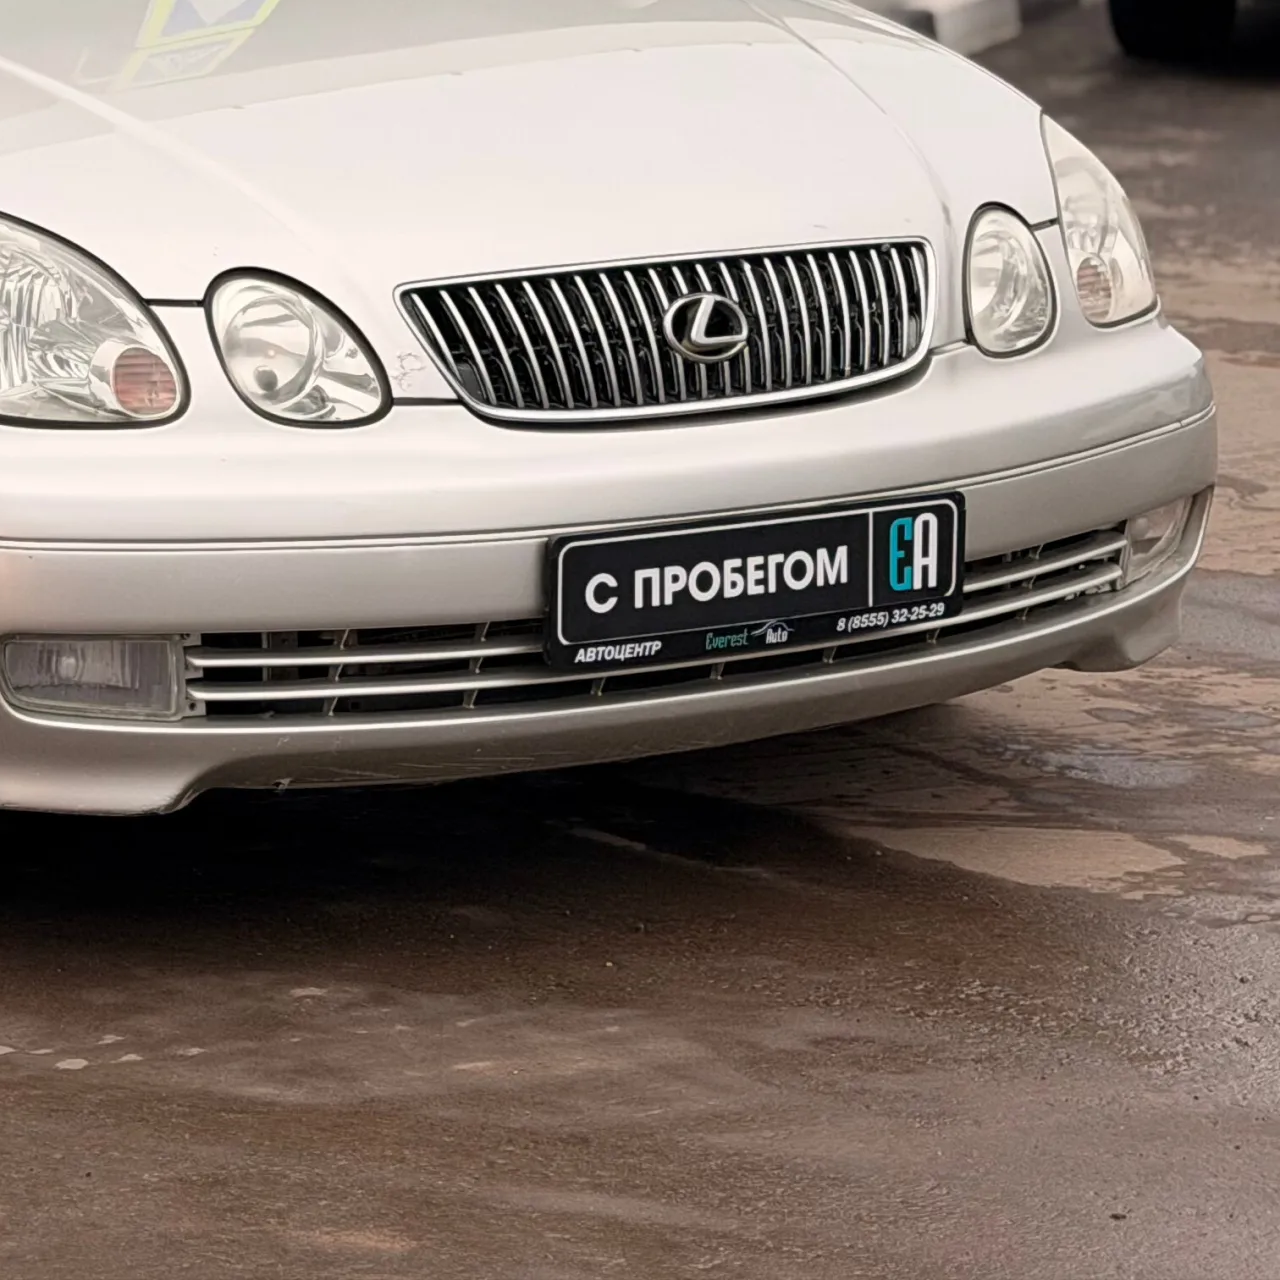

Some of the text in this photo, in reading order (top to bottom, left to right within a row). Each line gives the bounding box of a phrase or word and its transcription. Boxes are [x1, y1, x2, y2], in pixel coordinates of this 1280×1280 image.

[585, 545, 848, 614] С ПРОБЕГОМ
[836, 602, 945, 632] 8 (8555) 32-25-29
[574, 640, 662, 663] АВТОЦЕНТР
[705, 627, 788, 650] Everest Auto
